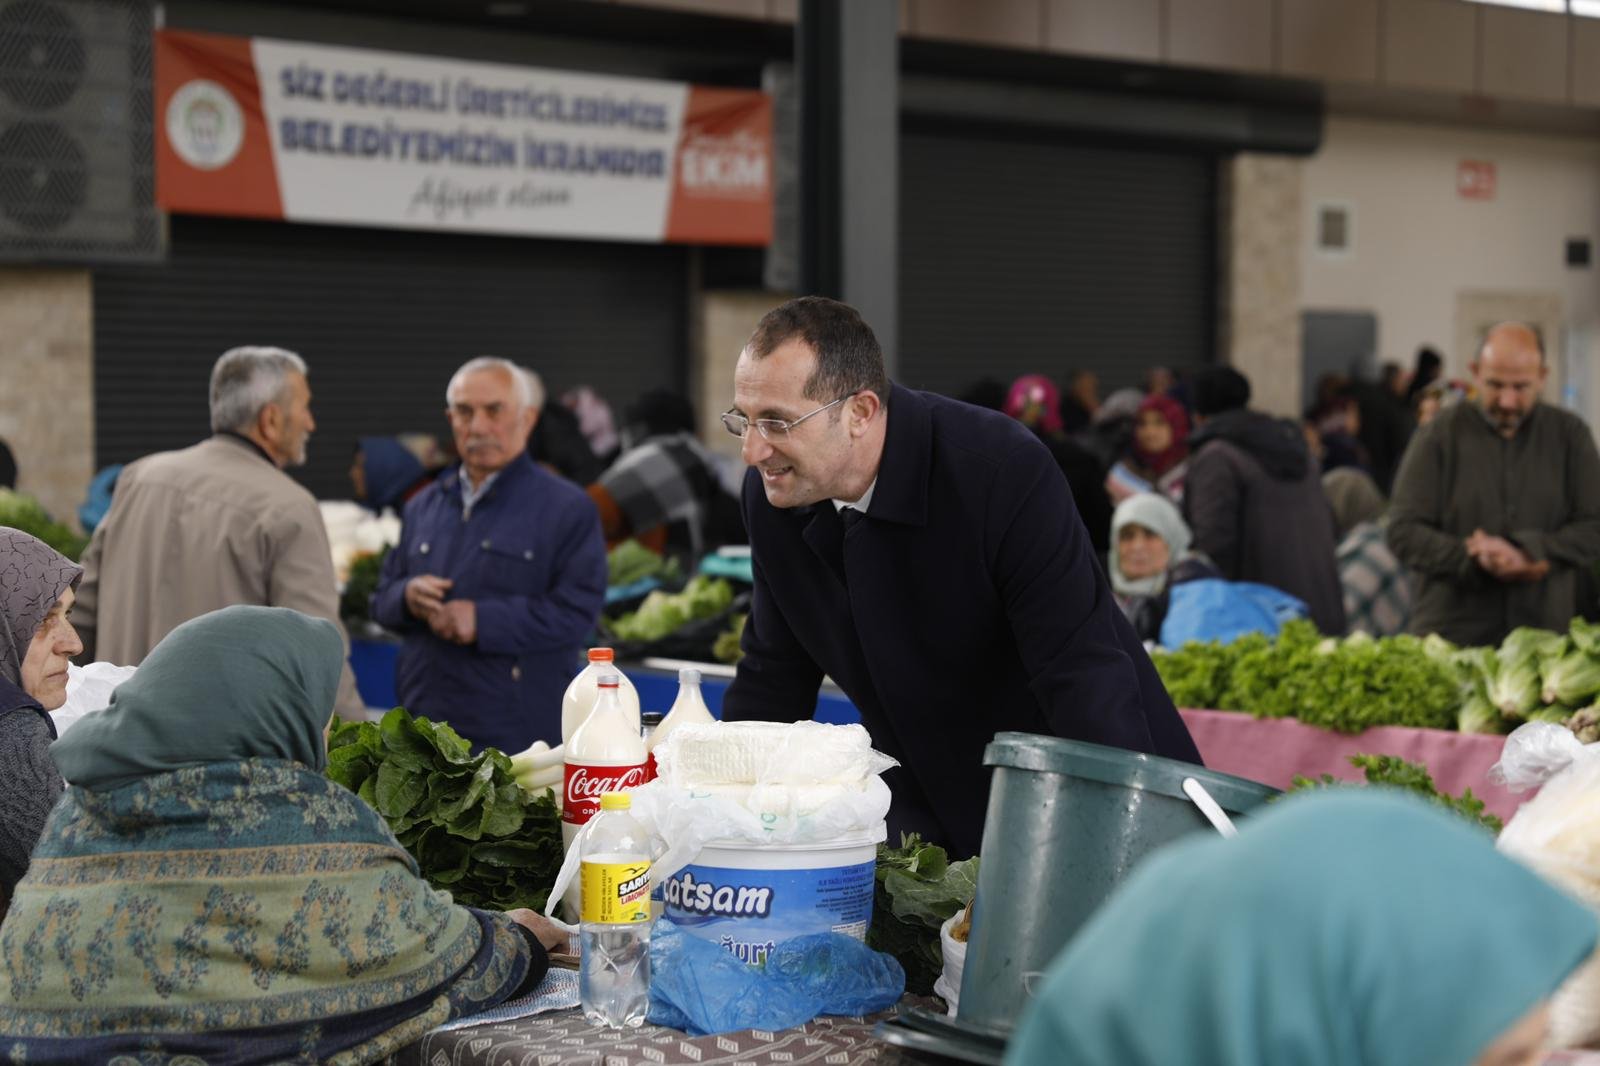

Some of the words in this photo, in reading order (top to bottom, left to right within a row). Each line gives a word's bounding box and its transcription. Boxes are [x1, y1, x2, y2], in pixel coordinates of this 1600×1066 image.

[280, 62, 325, 102] SİZ
[333, 67, 449, 113] DEĞERLİ
[456, 77, 669, 133] ÜRETİCİLERİMİZE
[279, 116, 516, 168] BELEDİYEMİZİN
[523, 130, 666, 181] İKRAMIDIR
[567, 768, 648, 804] Coca-C
